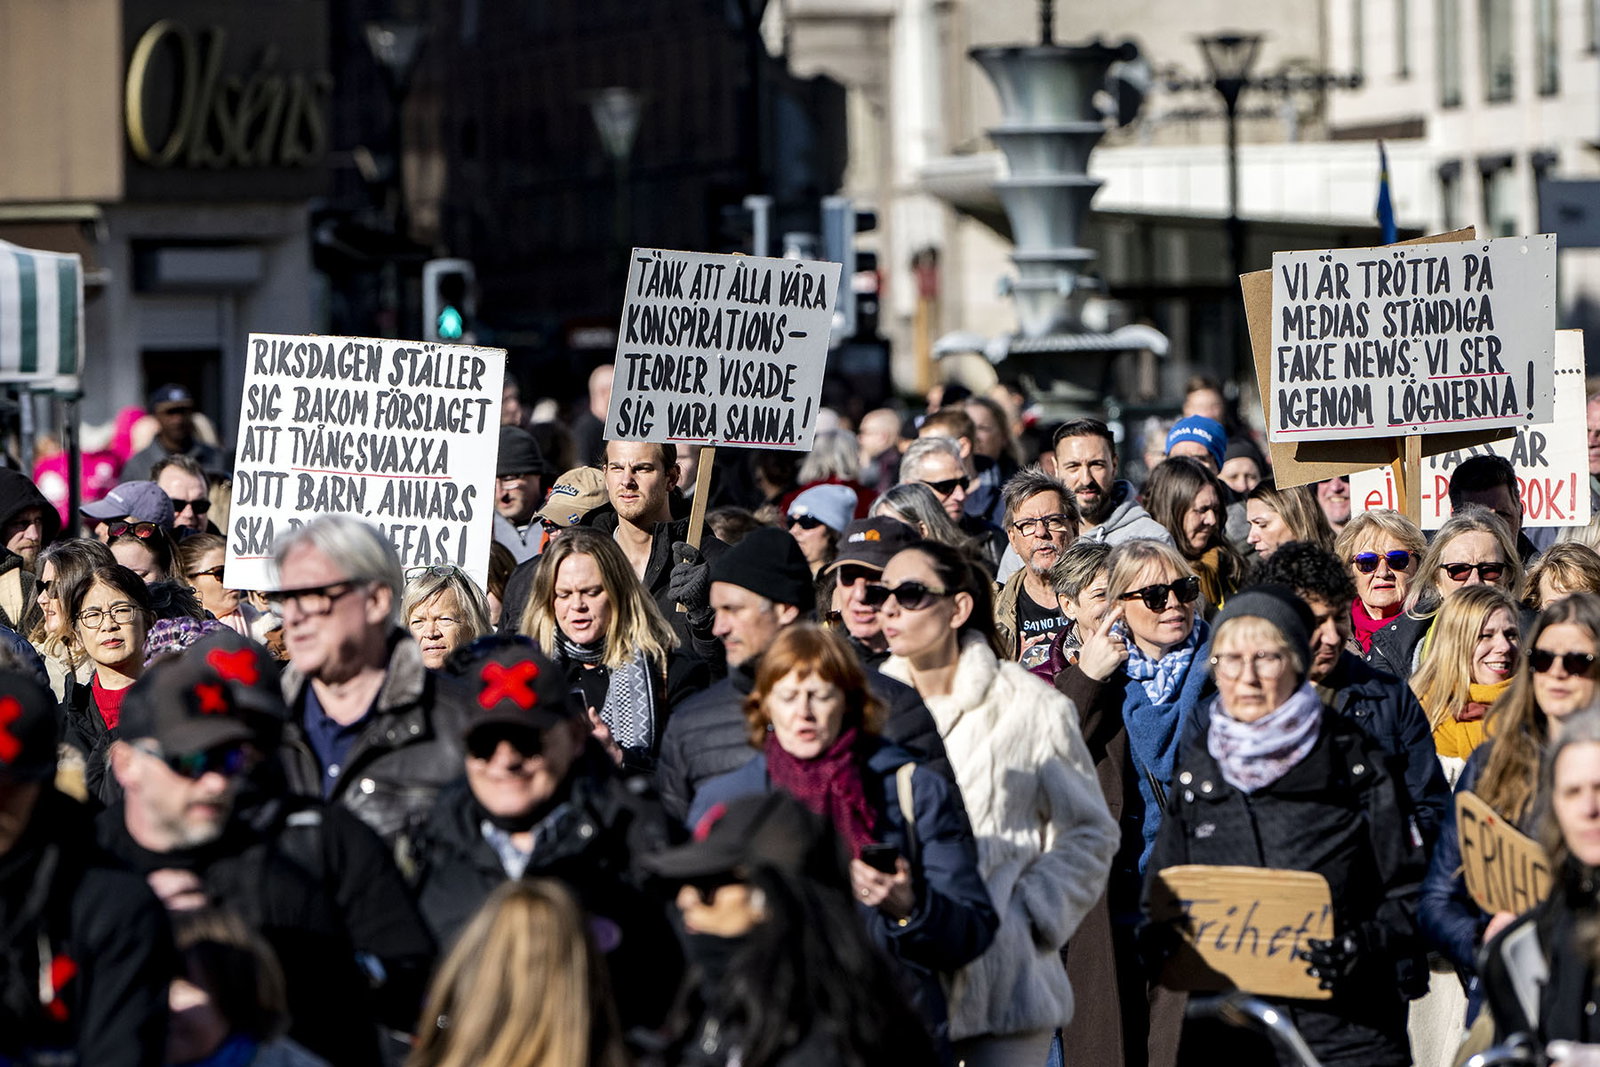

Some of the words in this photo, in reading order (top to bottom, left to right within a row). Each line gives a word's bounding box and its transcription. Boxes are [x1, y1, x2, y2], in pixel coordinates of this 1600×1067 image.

[636, 251, 689, 299] TÄNK
[689, 263, 726, 300] ATT
[726, 267, 771, 305] ALLA
[779, 264, 827, 310] VÅRA
[1282, 261, 1308, 301] VI
[1315, 255, 1350, 299] ÄR
[1356, 251, 1450, 298] TRÖTTA
[1462, 246, 1493, 292] PÅ
[1282, 302, 1370, 342] MEDIAS
[1383, 294, 1494, 337] STÄNDIGA
[252, 339, 383, 383] RIKSDAGEN
[388, 343, 487, 391] STÄLLER
[624, 353, 713, 397] TEORIER,
[719, 358, 798, 402] VISADE
[1277, 343, 1337, 383] FAKE
[1425, 338, 1449, 376] VI
[1460, 335, 1505, 374] SER
[247, 384, 282, 421] SIG
[292, 386, 368, 426] BAKOM
[374, 388, 493, 434] FÖRSLAGET
[616, 395, 655, 438] SIG
[667, 401, 717, 437] VARA
[724, 396, 811, 444] SANNA!
[1278, 384, 1374, 429] IGENOM
[240, 425, 282, 464] ATT
[288, 425, 449, 476] TVÅNGSVAXXA
[1510, 425, 1549, 468] ÄR
[237, 470, 289, 509] DITT
[295, 473, 373, 517] BARN,
[377, 480, 477, 522] ANNARS
[232, 516, 275, 556] SKA
[1040, 618, 1054, 630] NO
